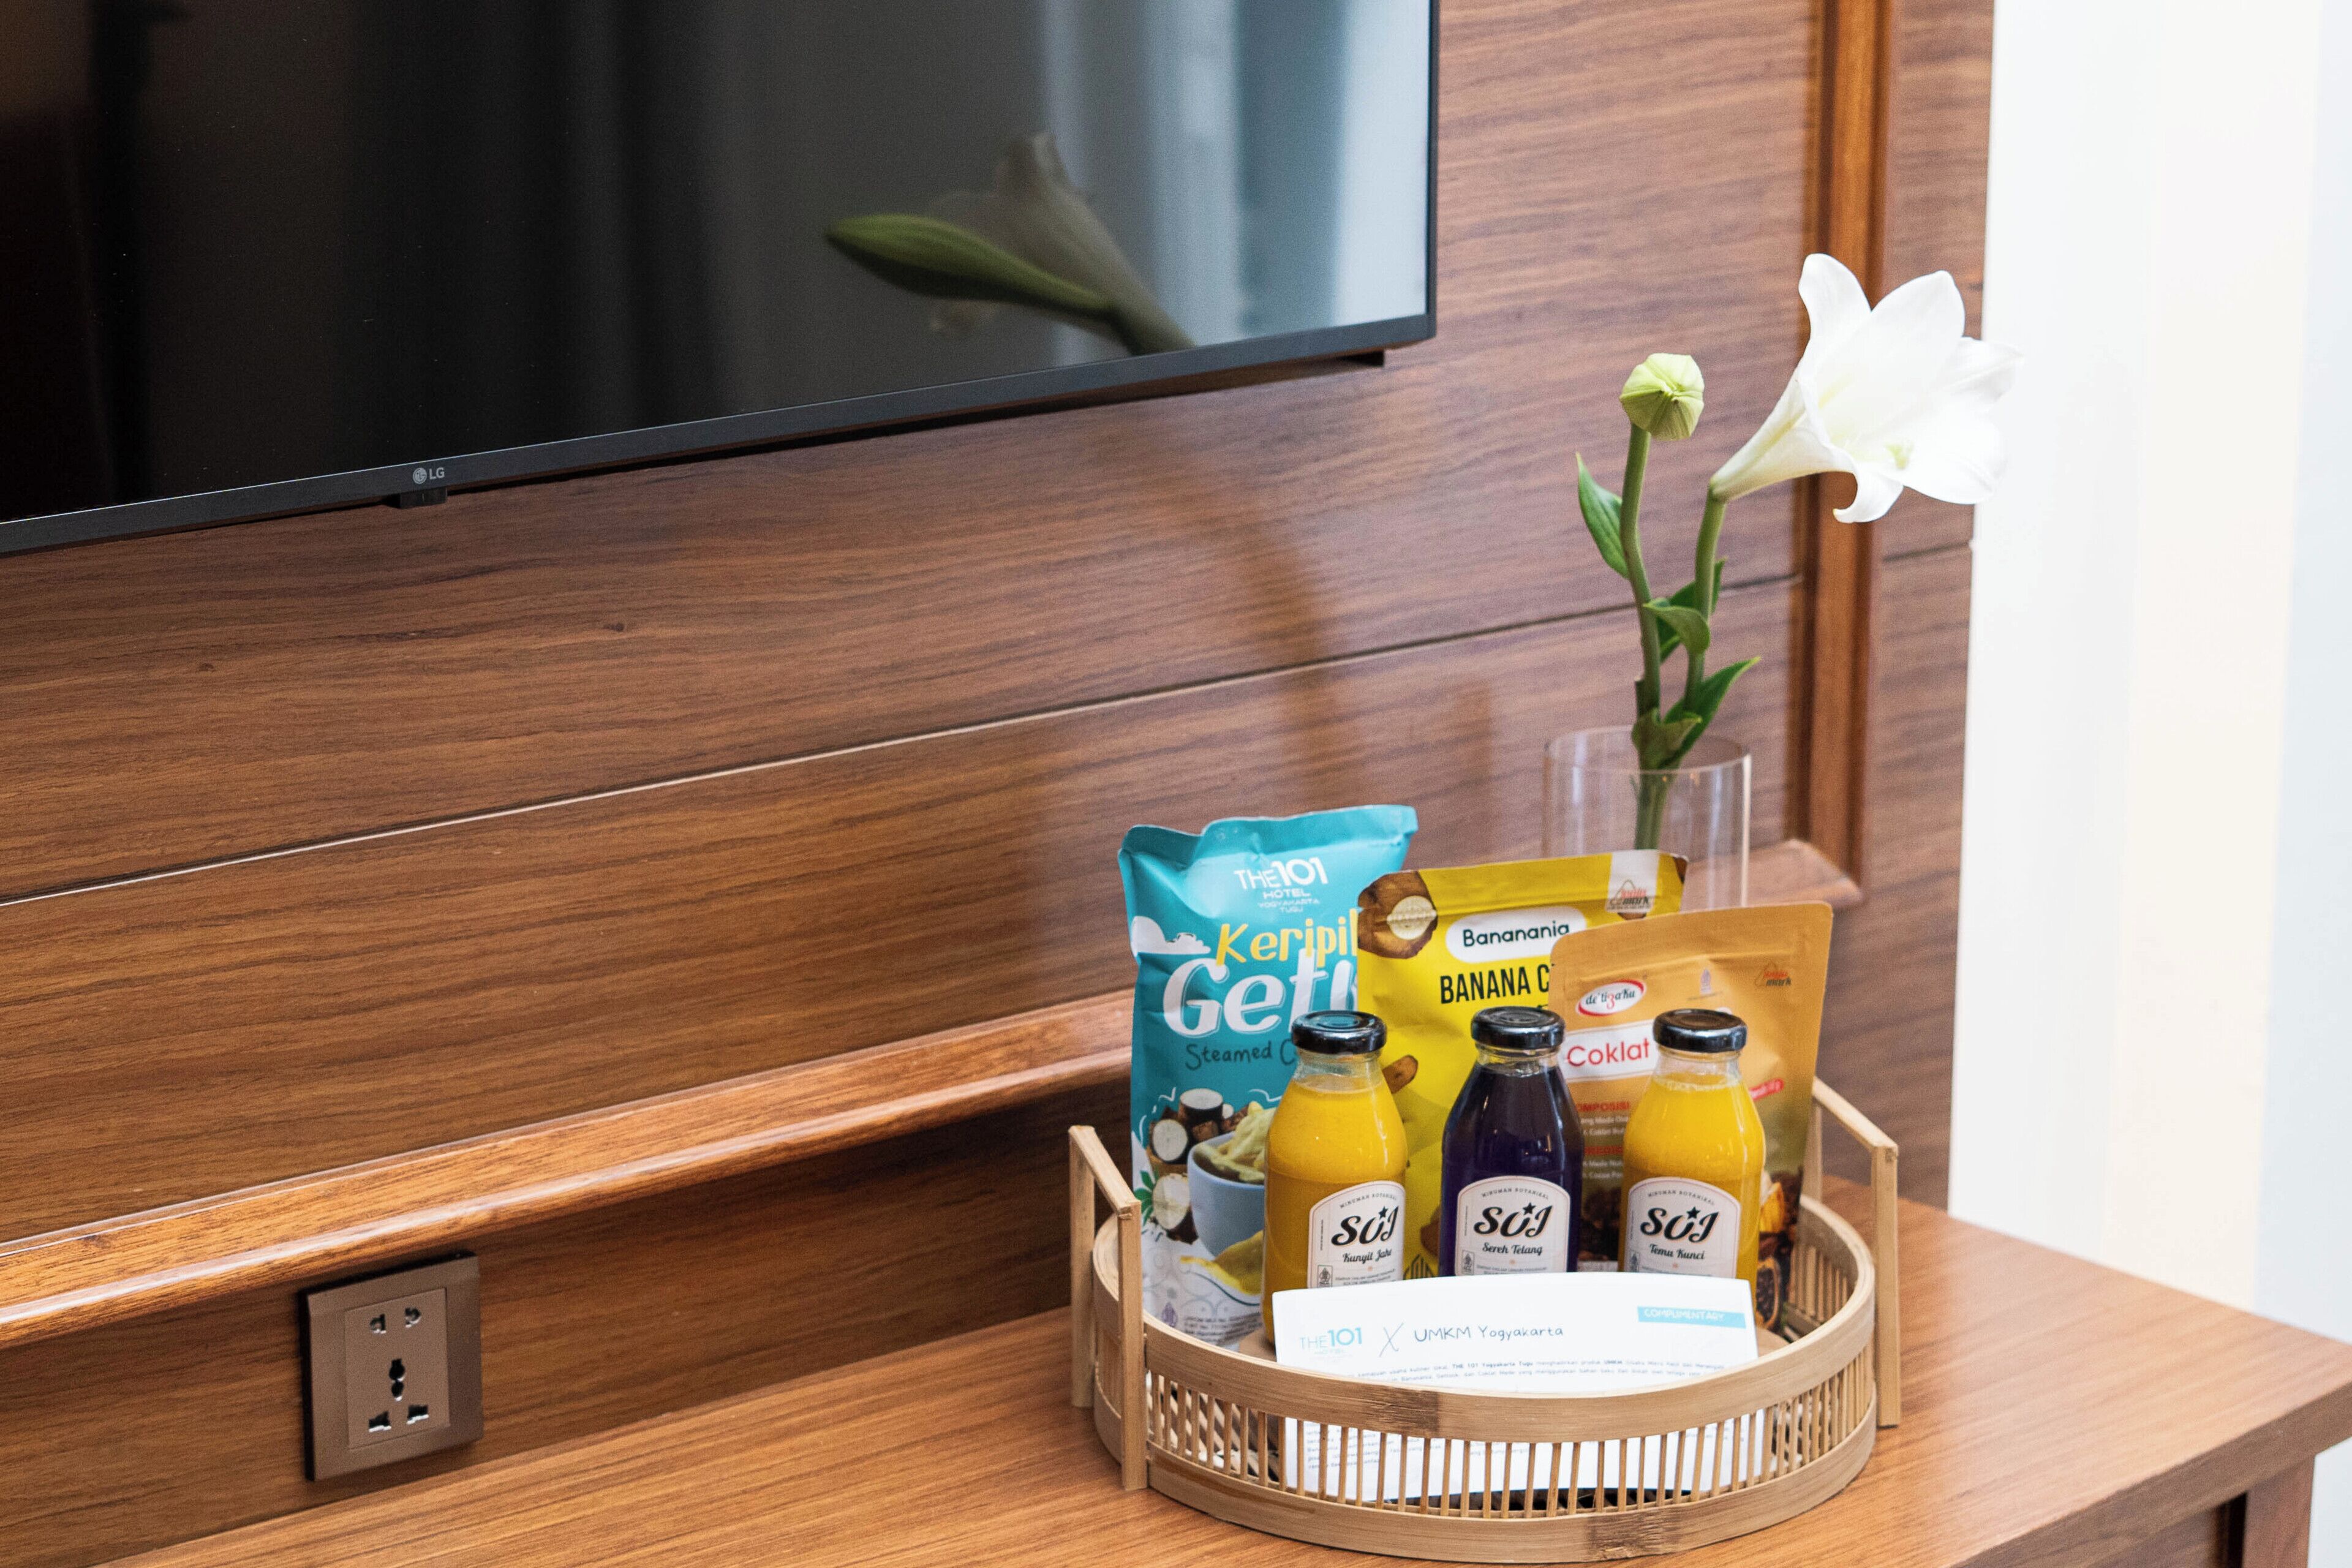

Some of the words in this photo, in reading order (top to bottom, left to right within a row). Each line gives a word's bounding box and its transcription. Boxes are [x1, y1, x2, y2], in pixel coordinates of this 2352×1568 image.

[429, 467, 445, 480] LG
[1262, 888, 1311, 900] HOTEL
[1463, 920, 1569, 948] Bananania
[1440, 966, 1531, 1004] BANANA
[1185, 1041, 1272, 1071] Steamed
[1567, 1038, 1649, 1067] Coklat
[1343, 1252, 1373, 1264] Kunyit
[1375, 1248, 1392, 1262] Jahe
[1482, 1242, 1509, 1254] Sereh
[1511, 1244, 1543, 1256] Telang
[1649, 1243, 1674, 1257] Temu
[1676, 1248, 1705, 1260] Kunci
[1644, 1308, 1725, 1322] COMPLIMENTARY
[1414, 1327, 1471, 1342] UMKM
[1478, 1325, 1564, 1341] Yogyakarta
